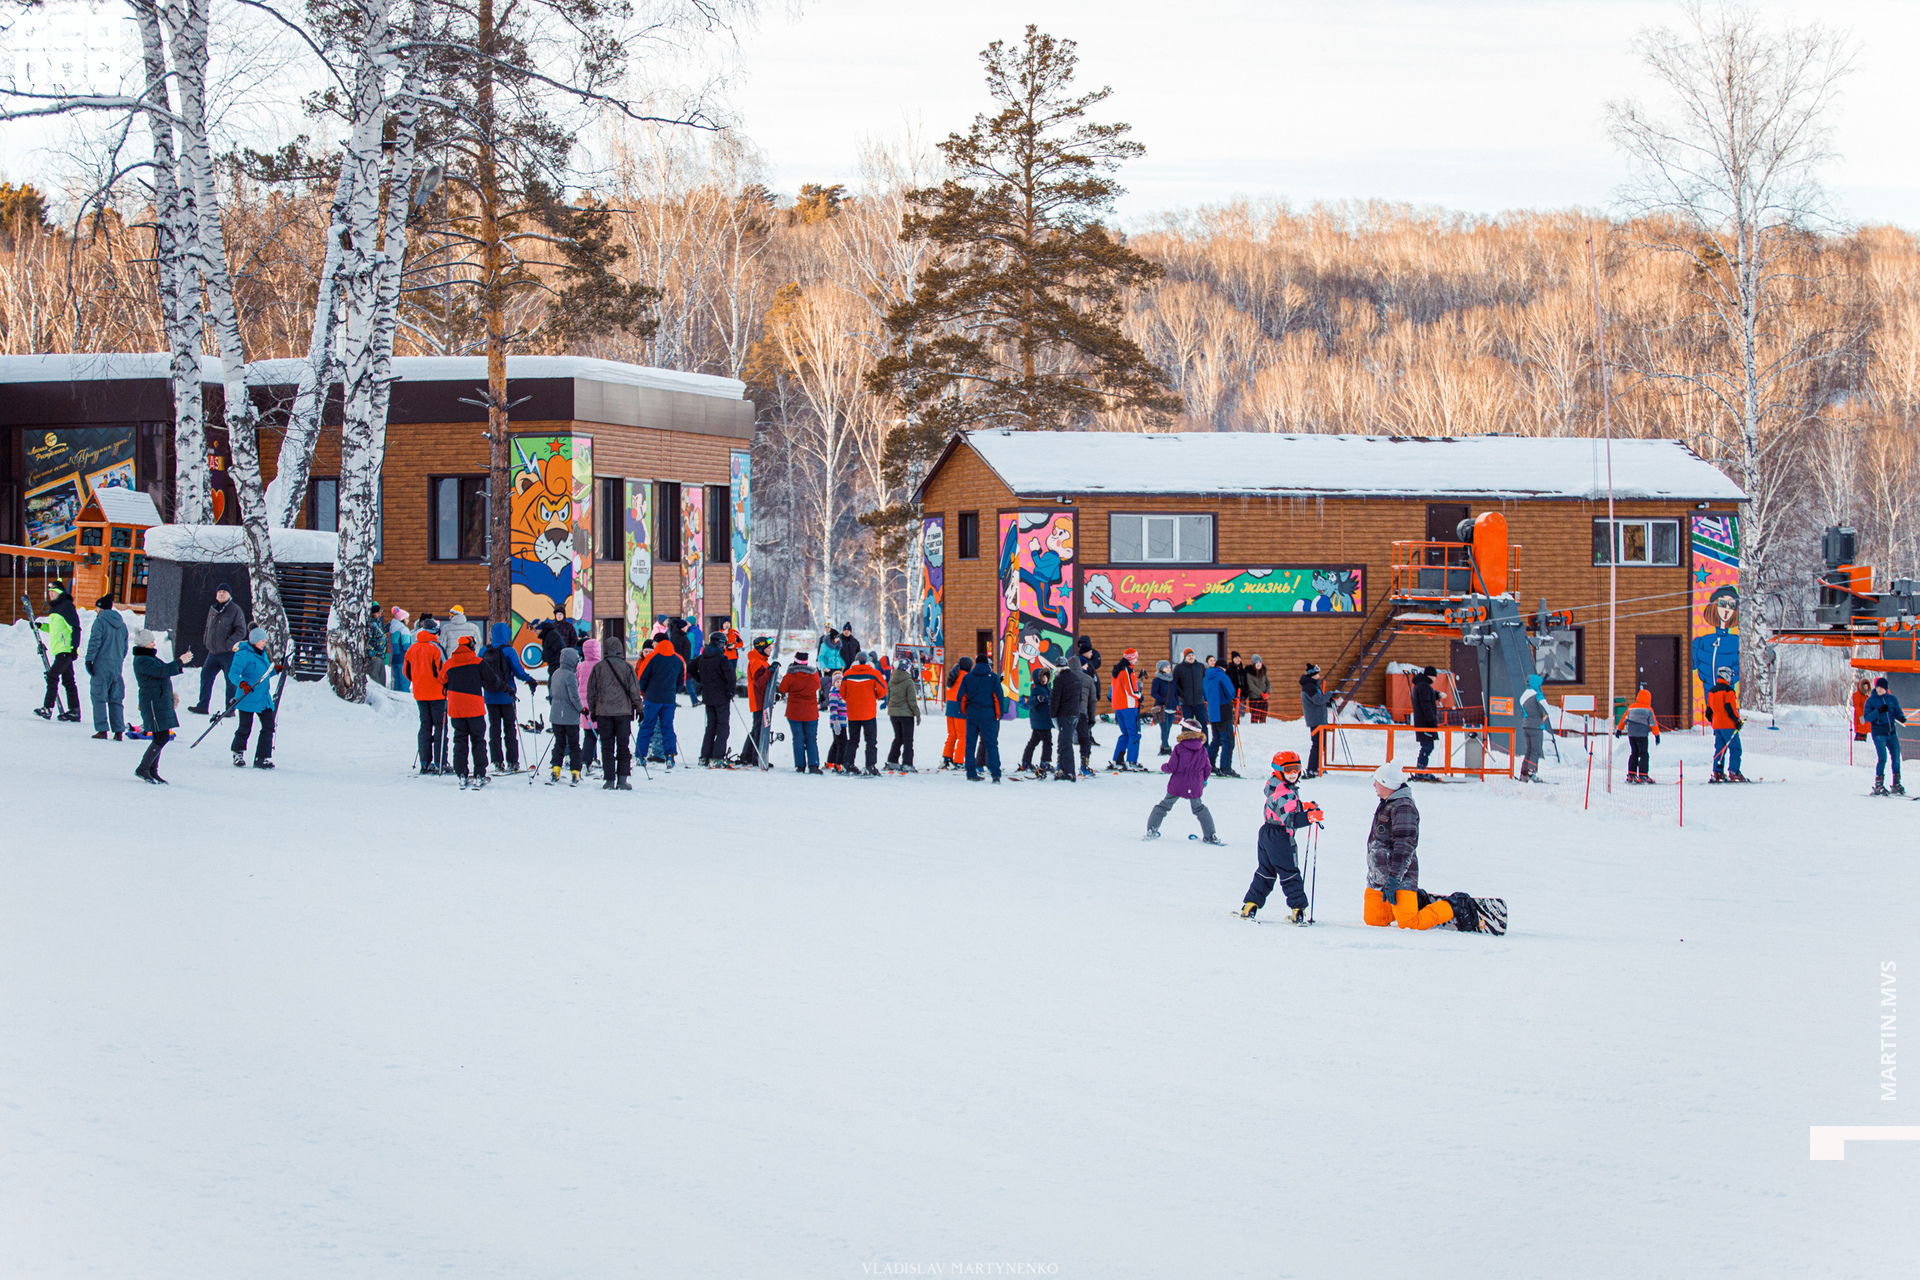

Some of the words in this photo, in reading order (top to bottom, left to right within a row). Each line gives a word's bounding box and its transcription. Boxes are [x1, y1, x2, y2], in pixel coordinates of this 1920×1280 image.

[1120, 575, 1174, 599] Спорт
[1202, 578, 1234, 594] это
[1240, 575, 1302, 594] жизнь!
